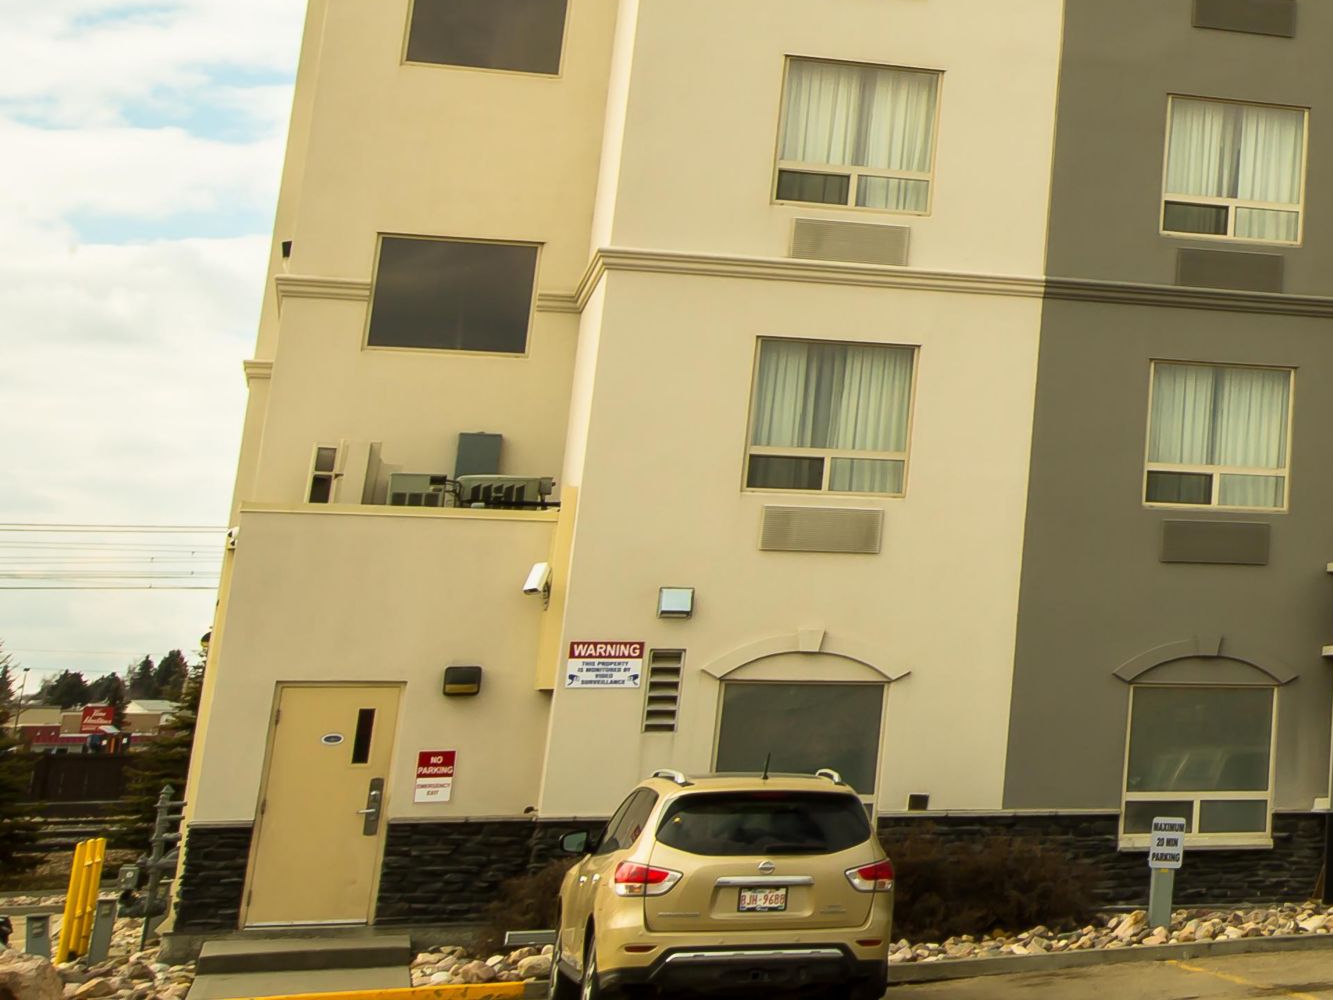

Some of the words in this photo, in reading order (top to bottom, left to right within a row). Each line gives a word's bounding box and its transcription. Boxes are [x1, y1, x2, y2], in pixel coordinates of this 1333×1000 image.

[573, 644, 640, 657] WARNING
[430, 756, 443, 764] NO
[417, 766, 453, 775] PARKING
[1153, 822, 1185, 832] MAXIMUM
[1166, 837, 1179, 847] MIN
[1151, 852, 1181, 862] PARKING
